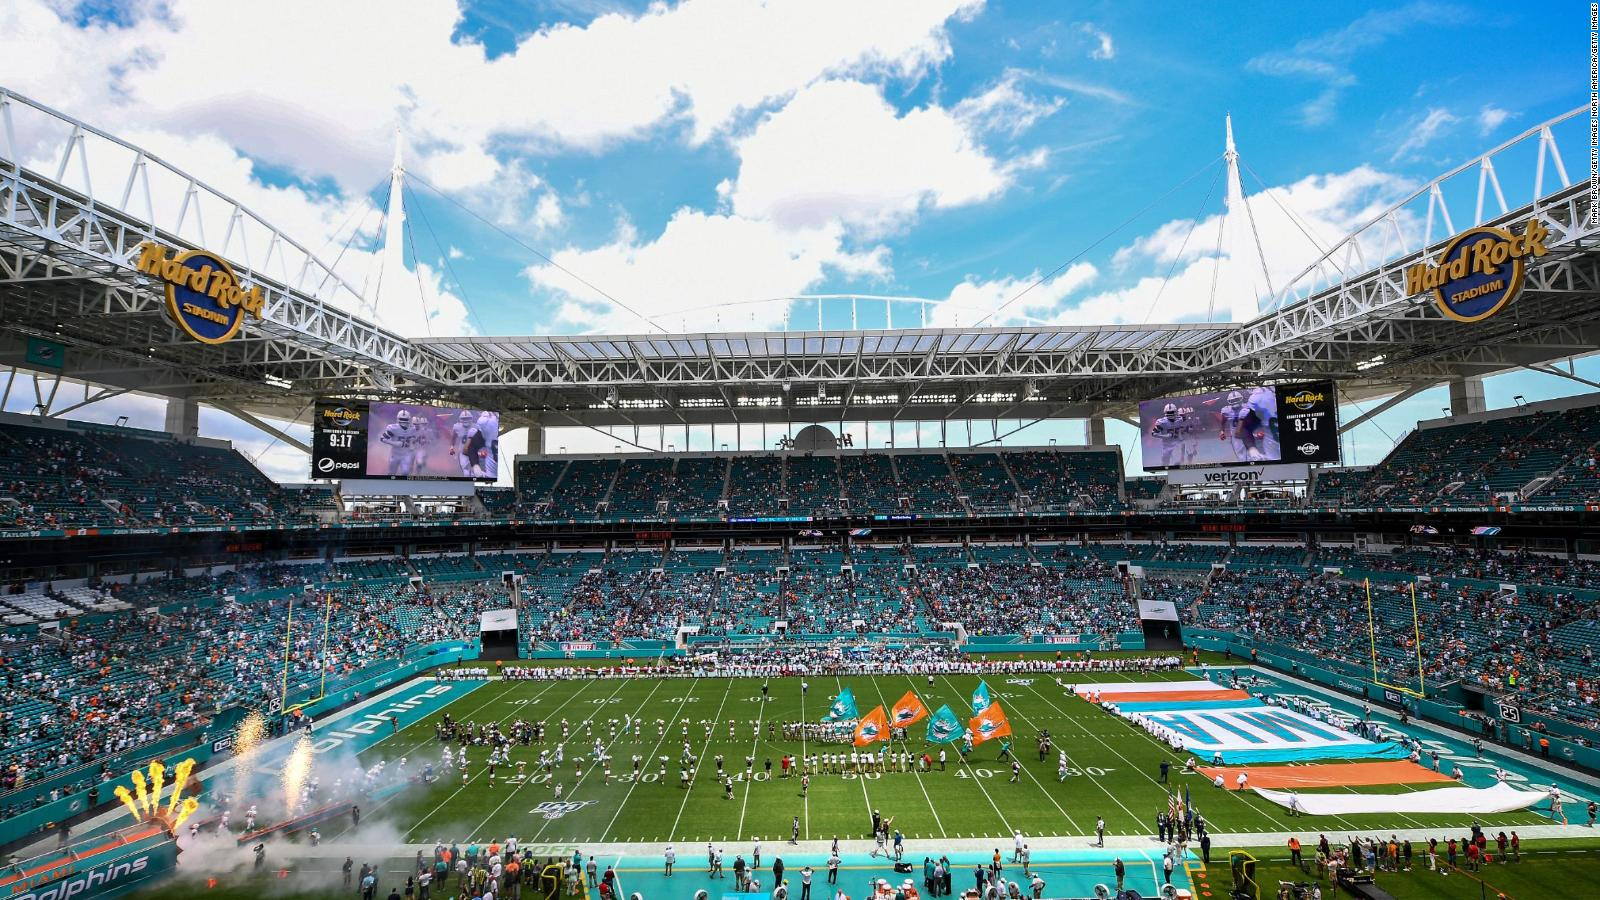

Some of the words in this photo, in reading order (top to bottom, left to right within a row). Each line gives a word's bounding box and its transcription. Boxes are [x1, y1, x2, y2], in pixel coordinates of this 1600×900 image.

[1407, 244, 1470, 296] Hard
[1471, 219, 1548, 274] Rock
[137, 241, 210, 292] Hard
[207, 269, 265, 320] Rock
[1451, 279, 1504, 305] STADIUM
[183, 302, 229, 326] STADIUM
[1285, 394, 1305, 404] Hard
[1305, 392, 1324, 403] Rock
[323, 409, 343, 418] Hard
[343, 411, 360, 421] Rock
[1294, 417, 1318, 432] 9:17
[329, 433, 353, 448] 9:17
[335, 461, 360, 469] pepsi
[1204, 469, 1259, 482] verizon
[271, 699, 281, 711] 25
[312, 684, 454, 754] olphins
[1503, 707, 1517, 720] 25
[617, 772, 659, 783] 30
[953, 768, 994, 779] 40
[12, 866, 75, 894] MIAMI
